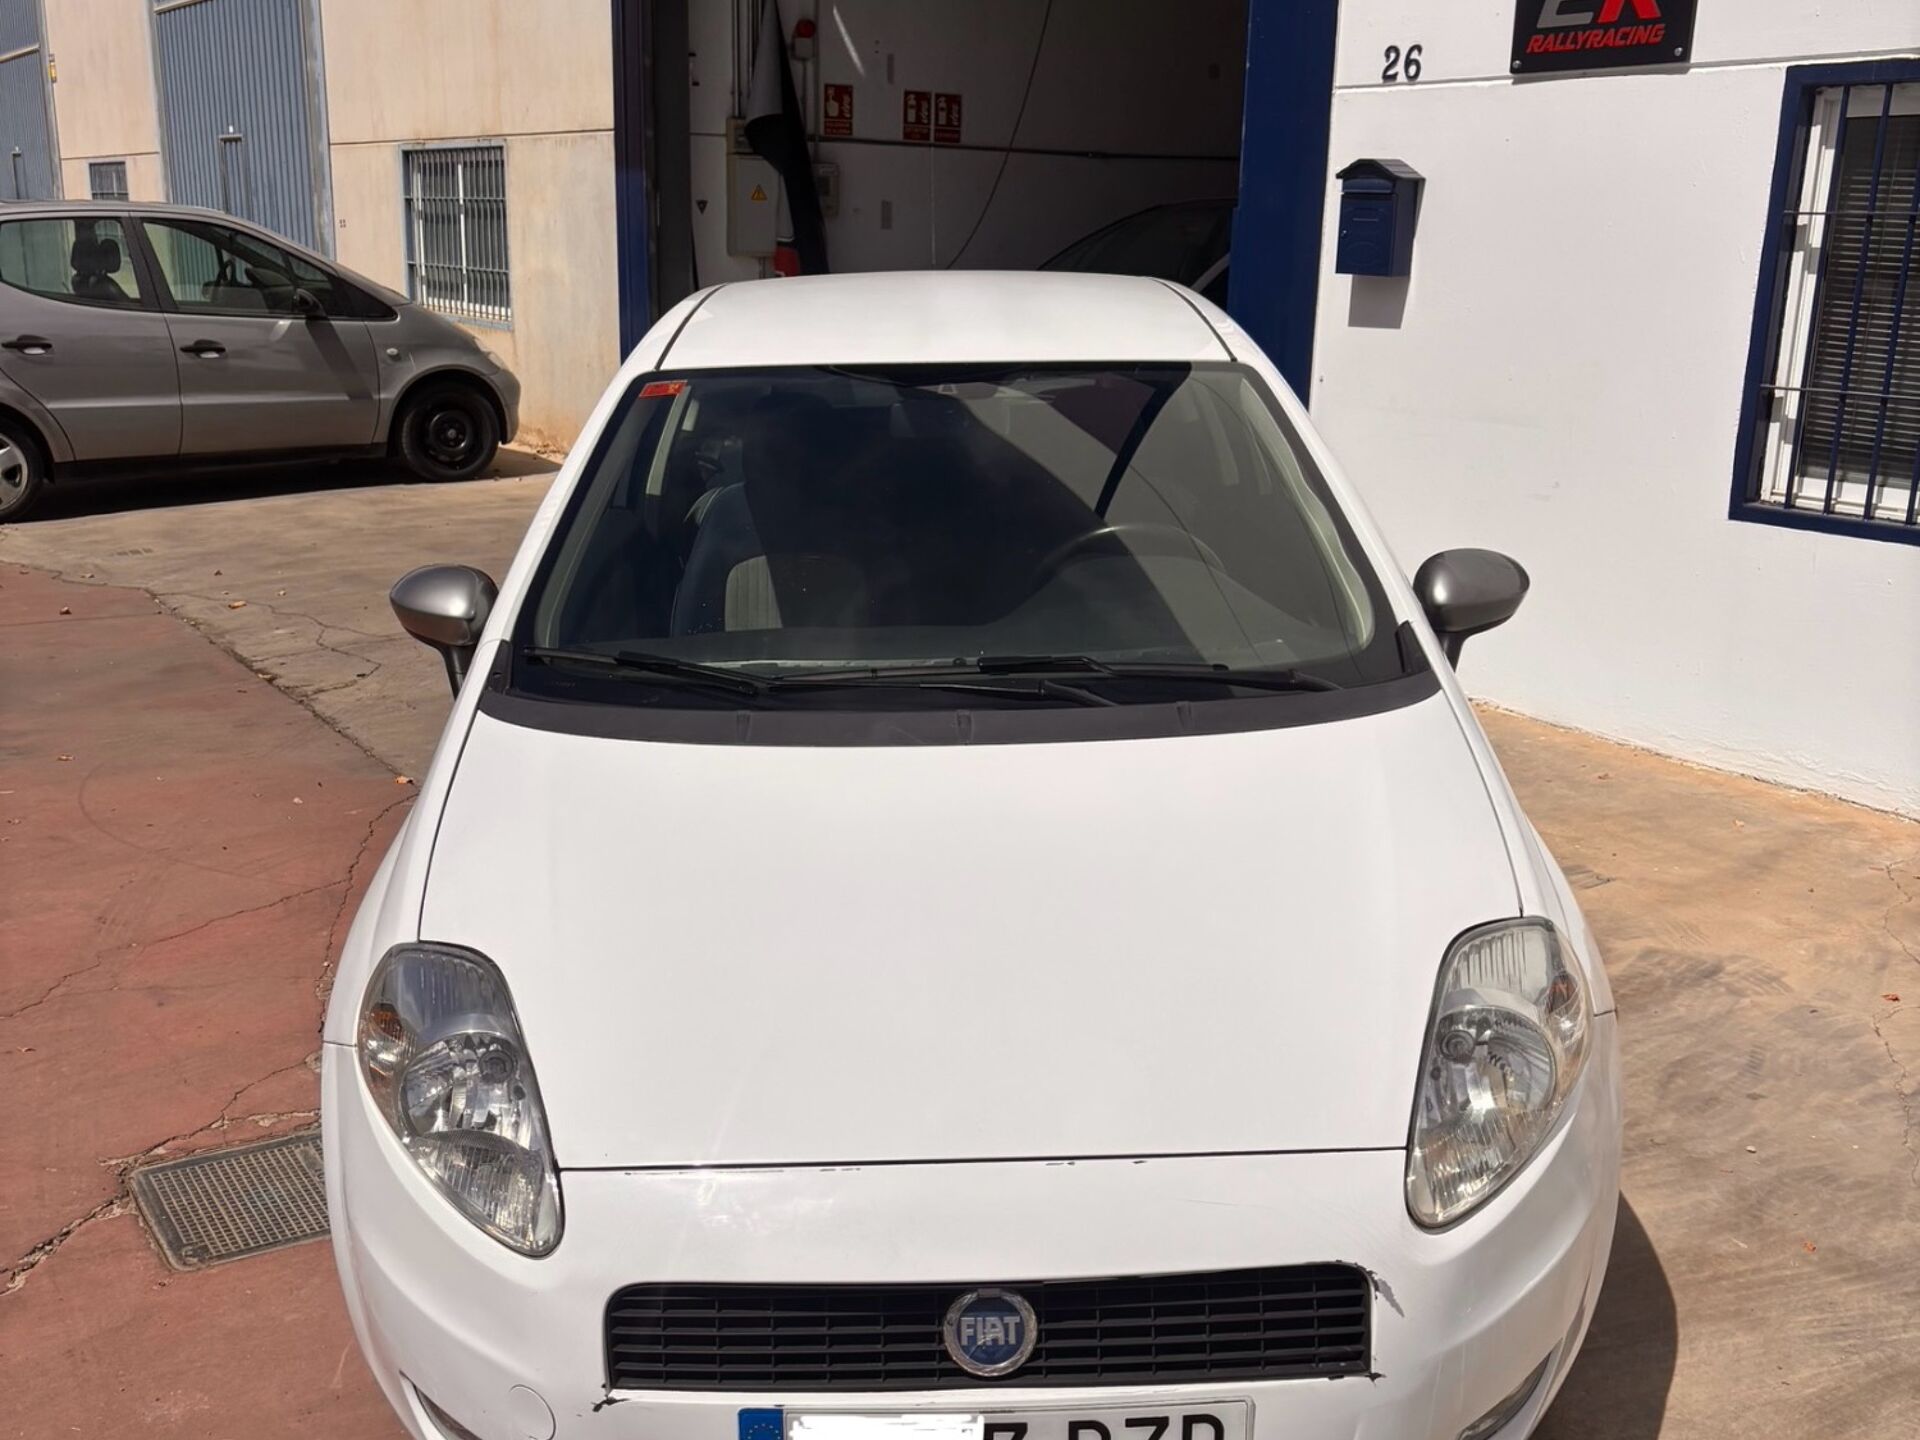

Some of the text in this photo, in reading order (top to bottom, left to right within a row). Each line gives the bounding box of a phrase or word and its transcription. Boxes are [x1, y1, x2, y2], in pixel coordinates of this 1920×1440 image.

[1526, 25, 1665, 53] RALLYRACING
[1381, 44, 1423, 83] 26
[960, 1315, 1021, 1346] FIAT
